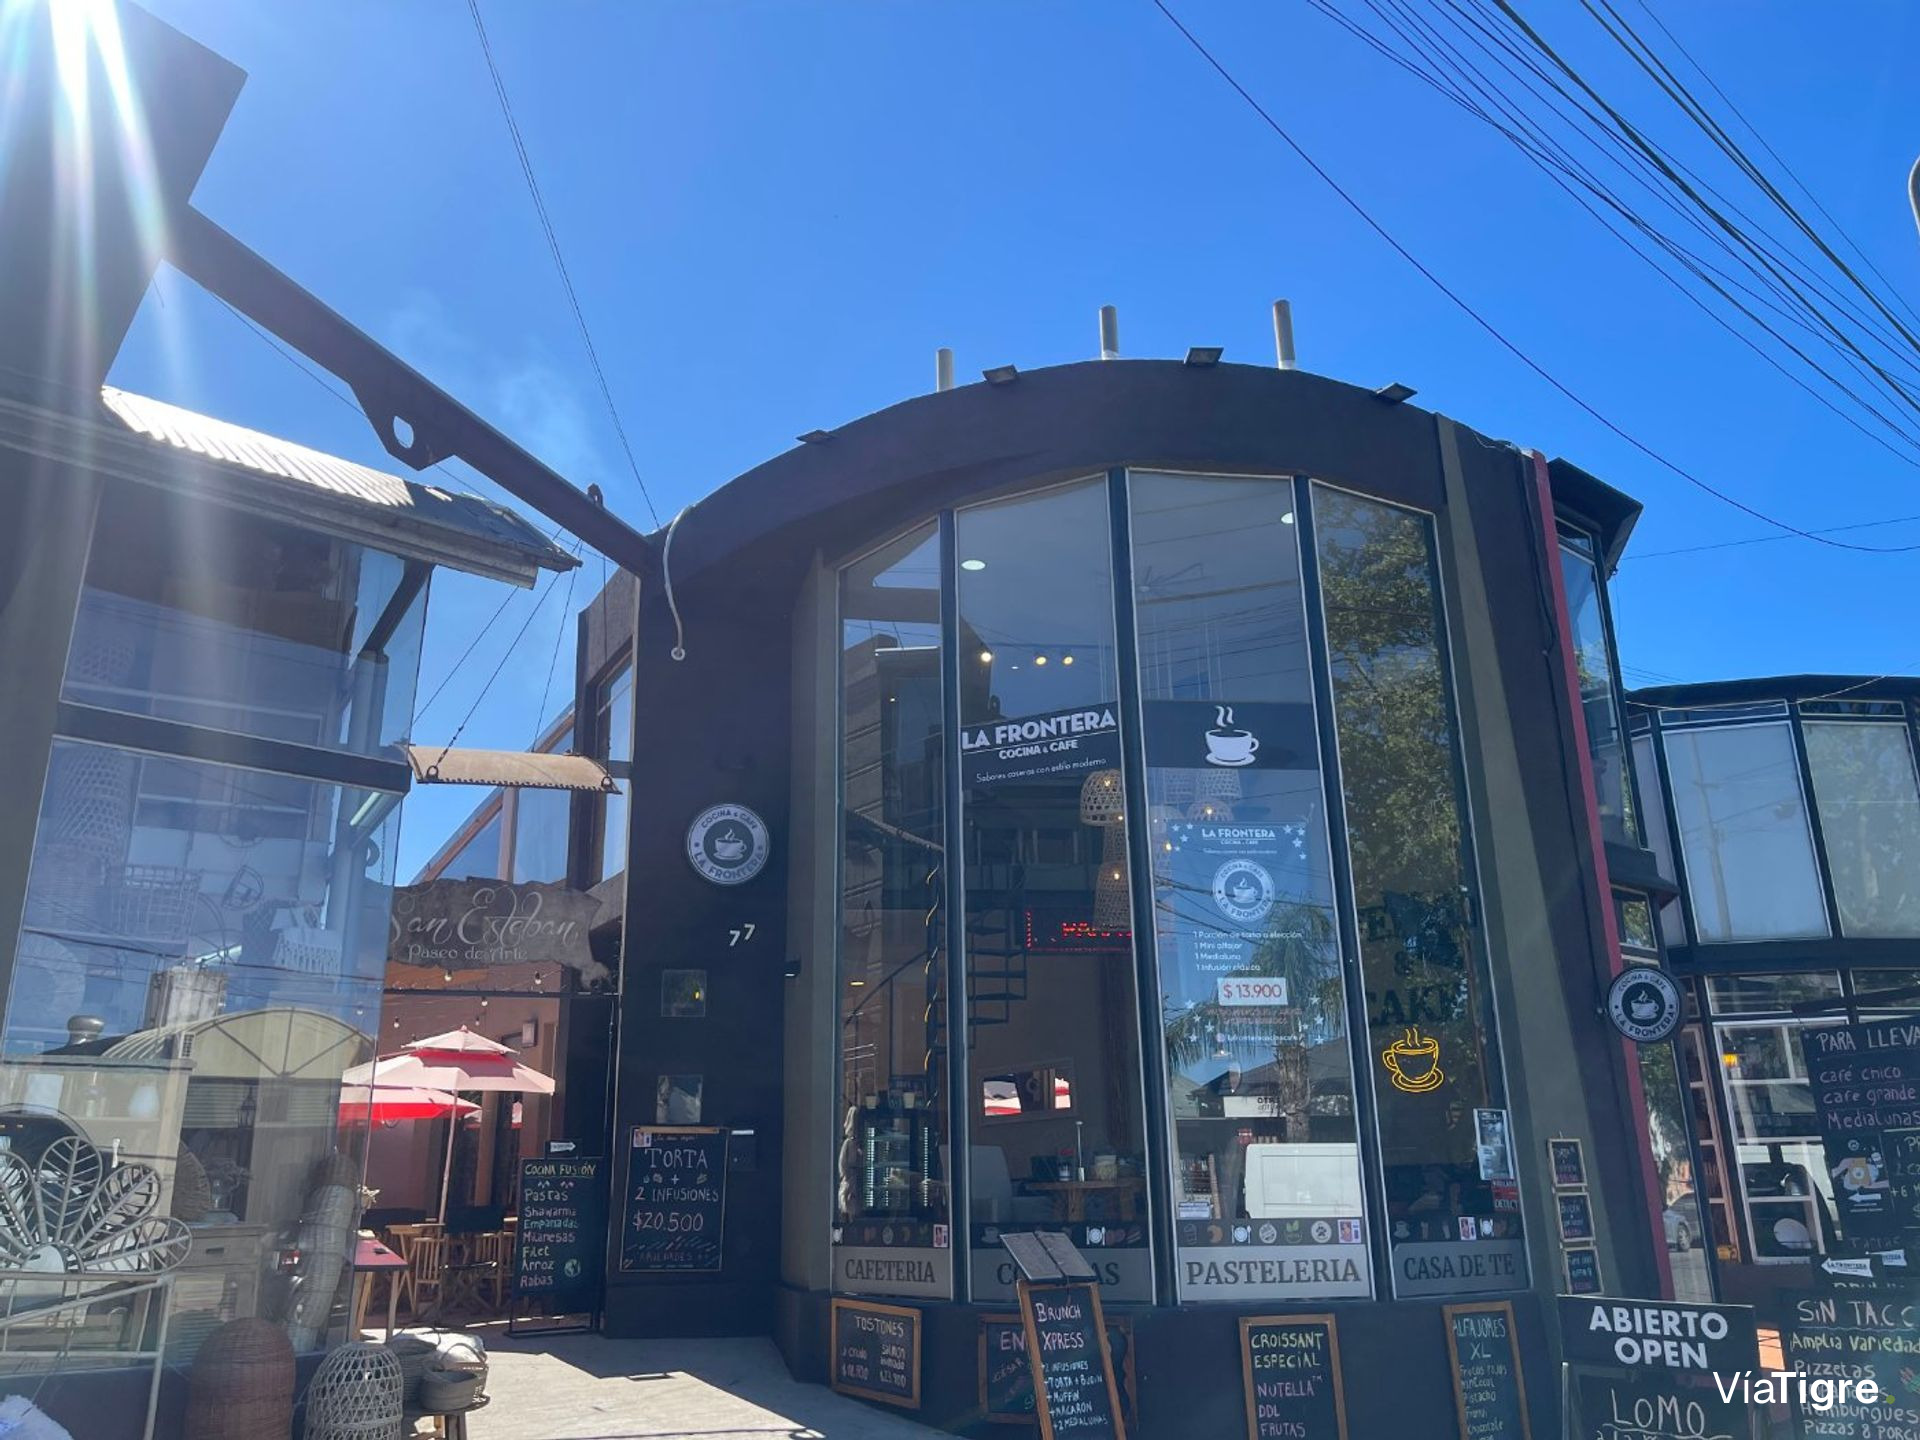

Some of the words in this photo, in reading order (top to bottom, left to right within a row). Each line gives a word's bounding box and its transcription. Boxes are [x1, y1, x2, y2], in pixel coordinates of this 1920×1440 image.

[962, 729, 990, 750] LA
[995, 708, 1117, 745] FRONTERA
[999, 745, 1041, 760] COCINA
[1050, 739, 1079, 752] CAFE
[1036, 766, 1050, 774] con
[1201, 827, 1216, 838] LA
[1218, 828, 1276, 838] FRONTERA
[729, 923, 756, 947] 77
[407, 944, 458, 962] Paseo
[1223, 984, 1233, 999] $
[1236, 984, 1282, 999] 13.900
[1815, 1031, 1857, 1053] PARA
[1866, 1083, 1917, 1106] grande
[644, 1148, 709, 1169] TORTA
[524, 1188, 569, 1202] Pastas
[634, 1186, 646, 1200] 2
[632, 1210, 704, 1232] $20.500
[521, 1258, 555, 1272] Arroz
[844, 1258, 936, 1284] CAFETERIA
[1185, 1257, 1363, 1287] PASTELERIA
[1403, 1256, 1455, 1281] CASA
[1460, 1254, 1486, 1278] DE
[1490, 1252, 1516, 1277] TE
[519, 1274, 554, 1289] Rabas
[1035, 1302, 1082, 1323] BRUNCH
[1588, 1305, 1729, 1341] ABIERTO
[853, 1315, 905, 1338] TOSTONES
[1042, 1330, 1085, 1352] XPRESS
[1251, 1331, 1325, 1351] CROISSANT
[1470, 1342, 1492, 1360] XL
[1613, 1336, 1708, 1369] OPEN
[1258, 1403, 1281, 1419] DDL
[1610, 1387, 1705, 1437] LOMO
[1260, 1421, 1306, 1439] FRUTAS
[1803, 1419, 1855, 1436] Pizzas
